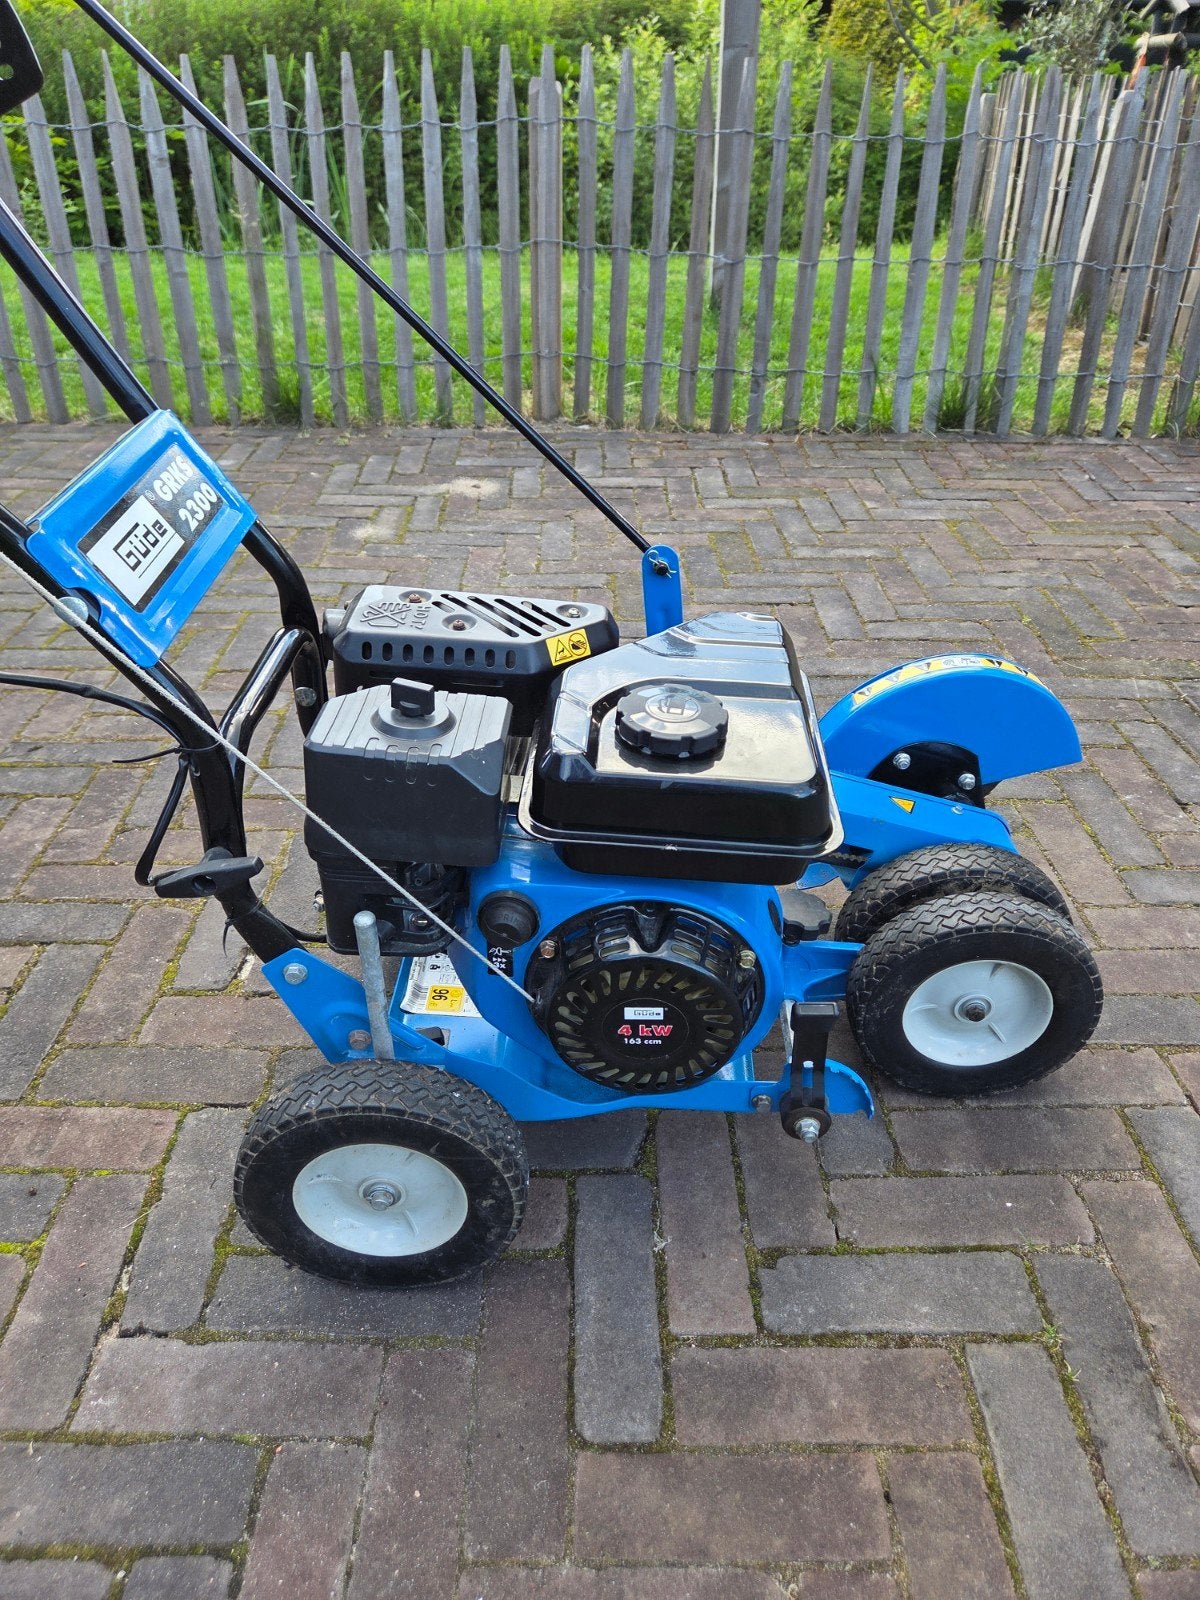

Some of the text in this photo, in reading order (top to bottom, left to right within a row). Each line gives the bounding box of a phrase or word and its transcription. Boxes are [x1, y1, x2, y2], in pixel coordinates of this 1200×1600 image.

[153, 455, 194, 502] GRKS
[178, 482, 218, 532] 2300
[112, 518, 168, 572] Güde
[432, 988, 449, 1001] 96
[618, 1024, 673, 1037] 4 kW
